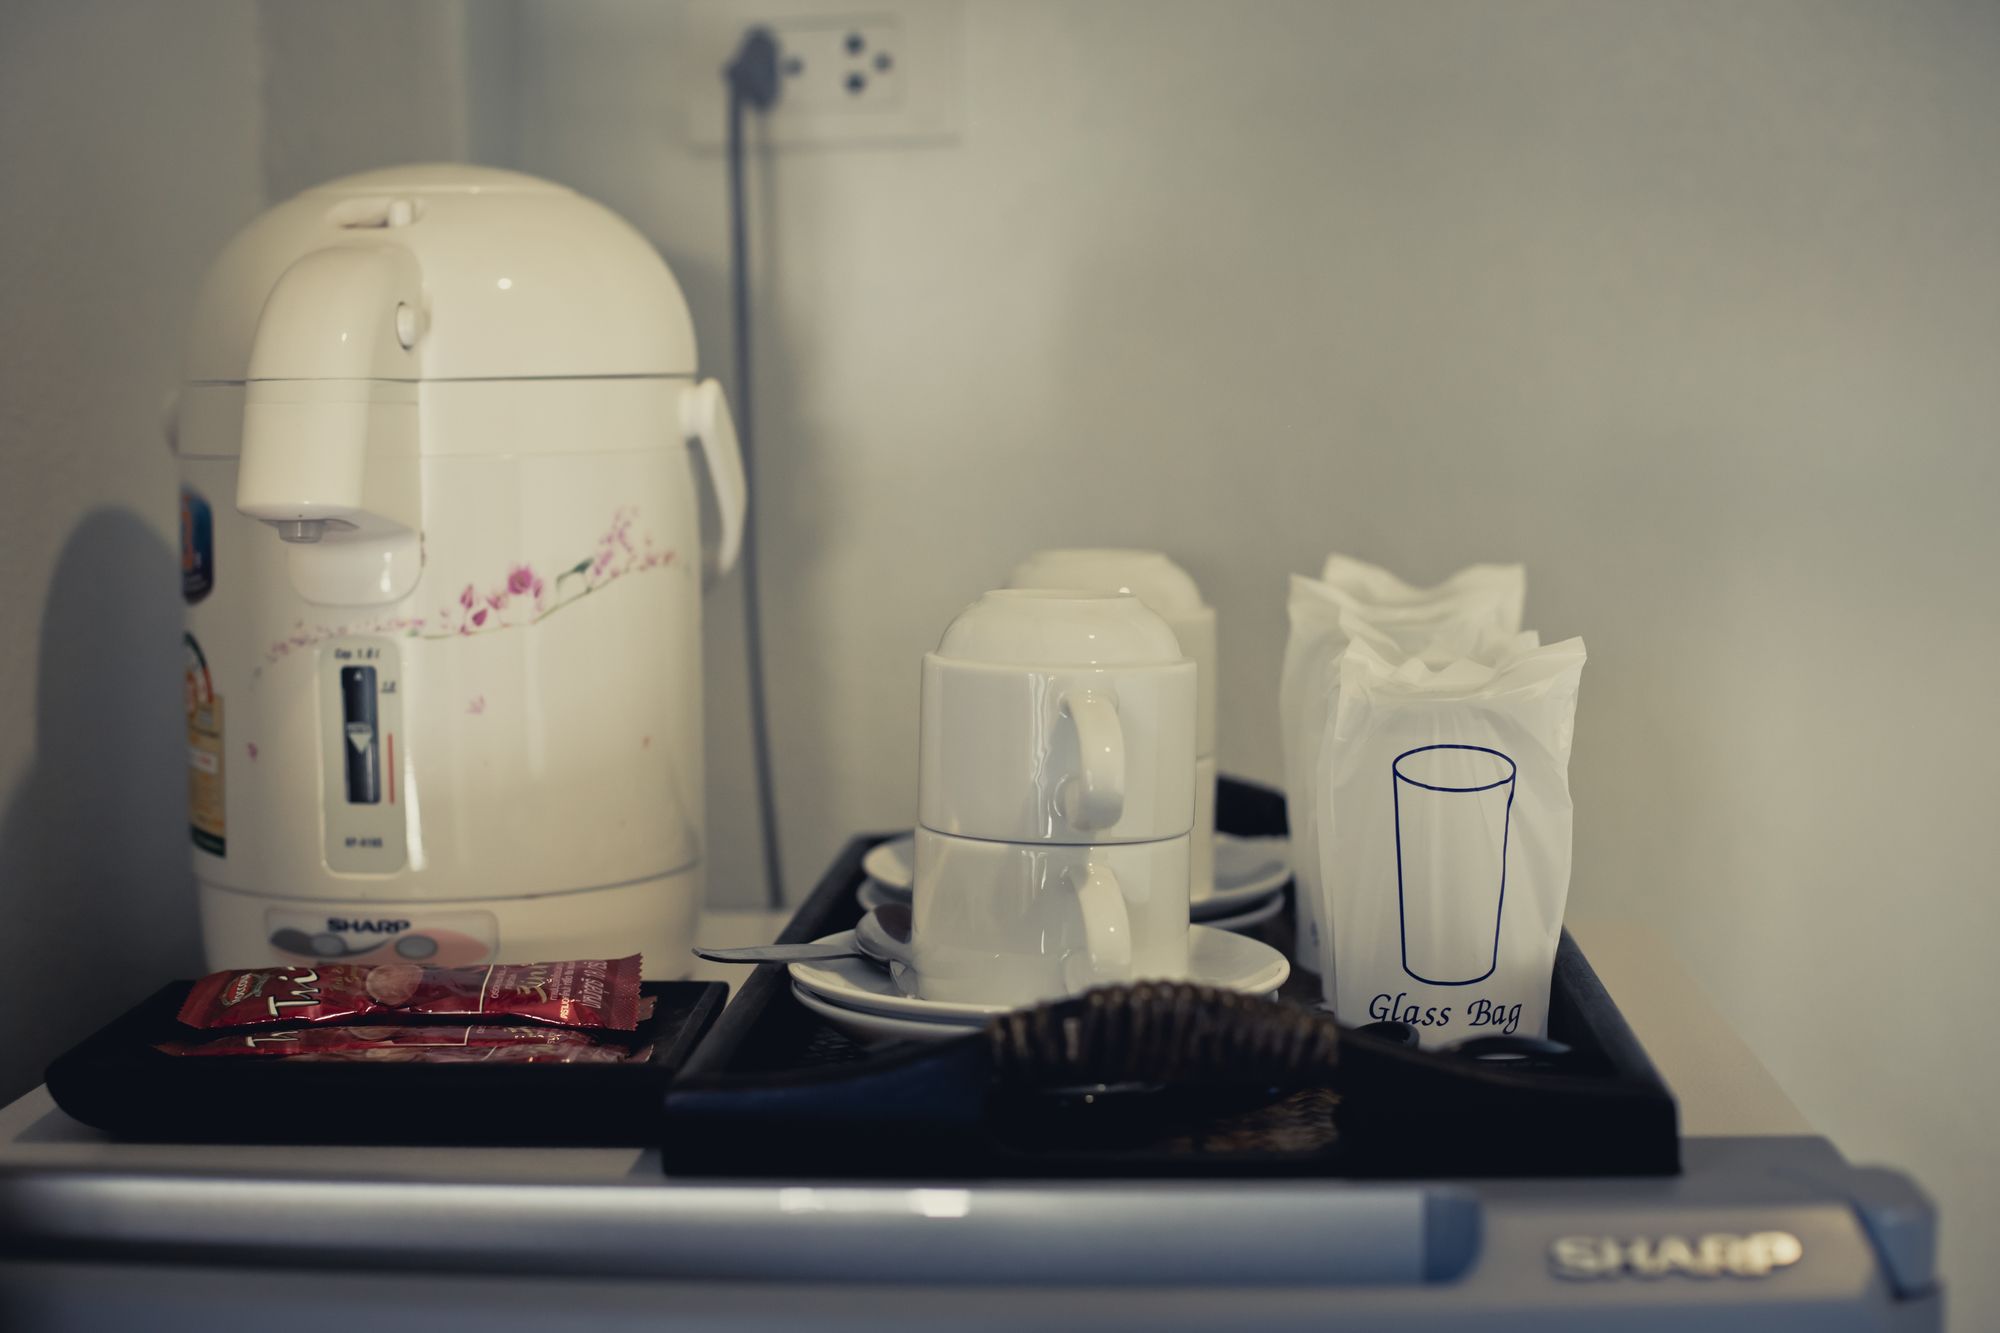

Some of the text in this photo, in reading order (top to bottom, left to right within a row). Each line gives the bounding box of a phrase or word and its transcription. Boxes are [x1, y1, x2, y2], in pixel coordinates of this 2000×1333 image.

[326, 918, 411, 933] SHARP
[1369, 993, 1522, 1035] Glass Bag
[1550, 1231, 1802, 1282] SHARP
